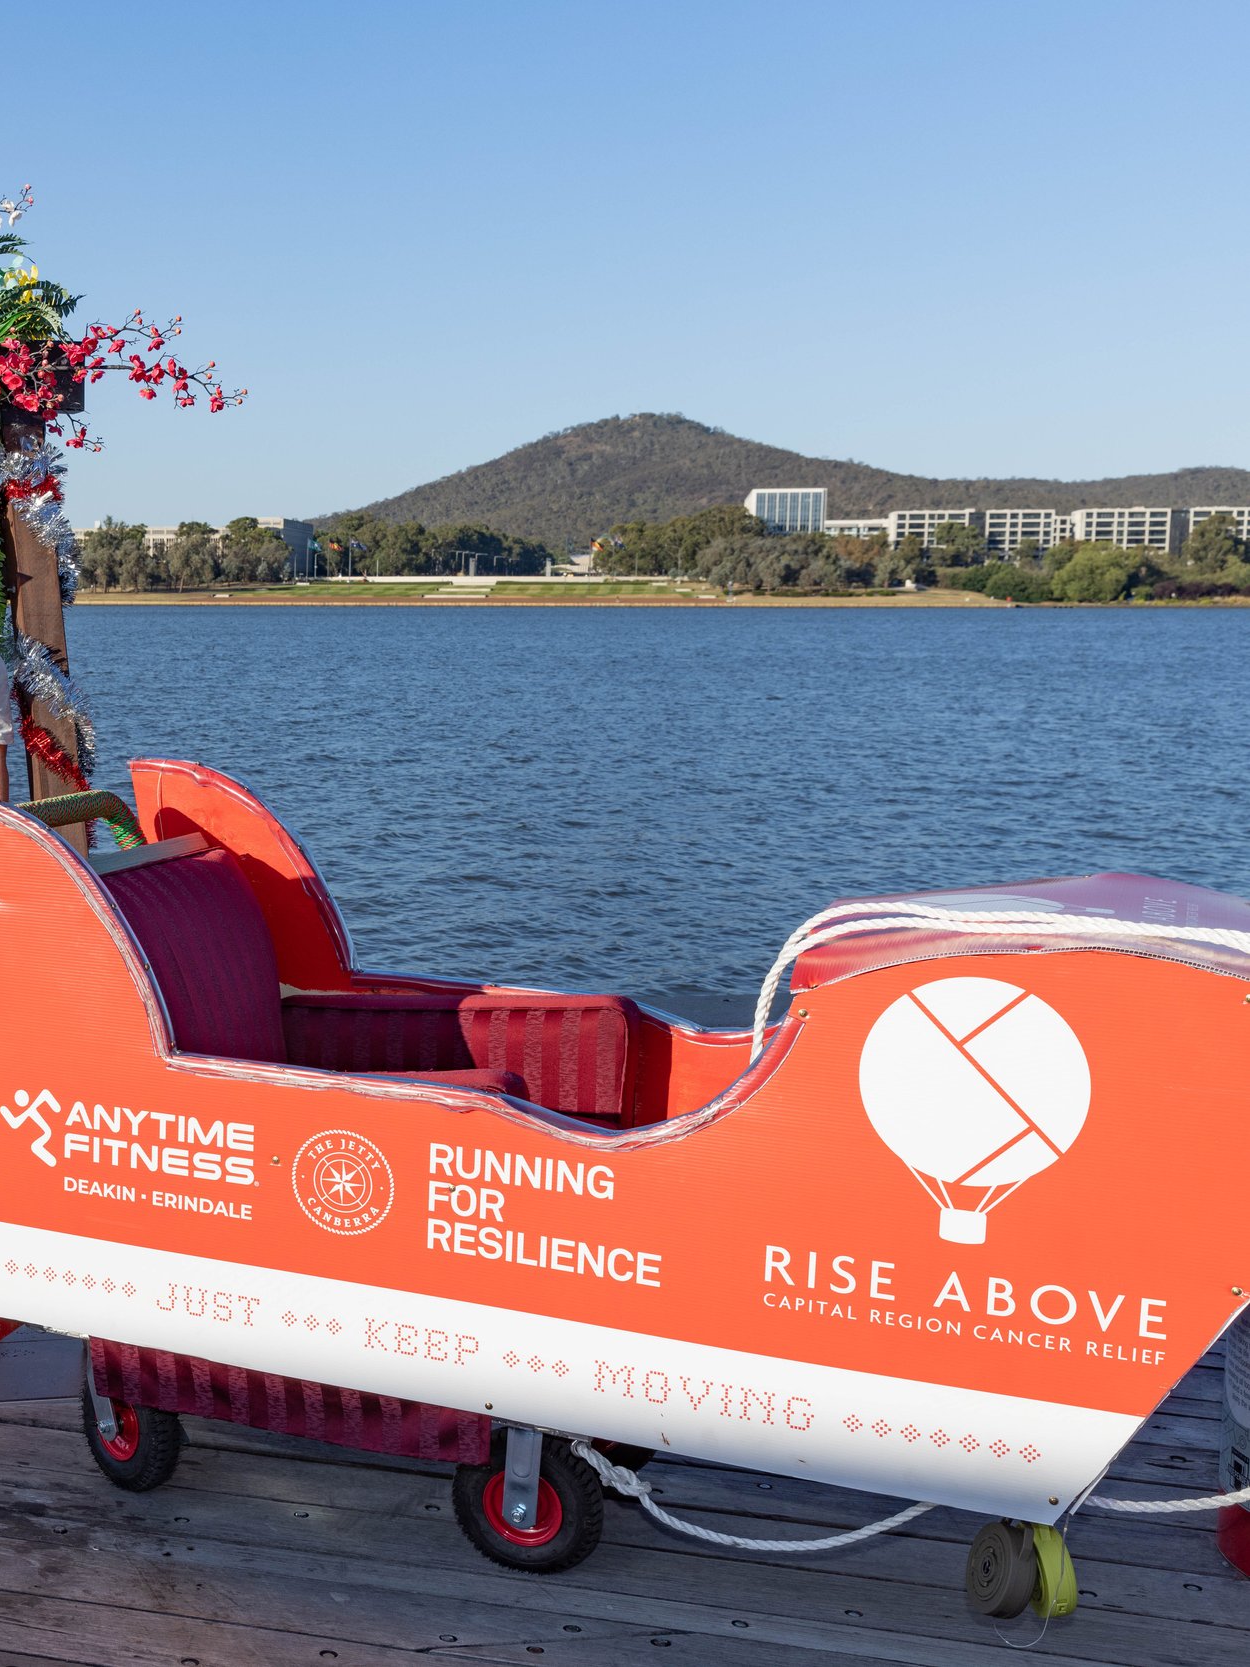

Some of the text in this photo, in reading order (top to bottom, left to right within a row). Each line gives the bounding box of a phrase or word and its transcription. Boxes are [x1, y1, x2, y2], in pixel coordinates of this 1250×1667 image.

[64, 1101, 255, 1152] ANYTIME
[63, 1132, 255, 1186] FITNESS
[307, 1138, 381, 1170] THE JETTY
[429, 1142, 615, 1200] RUNNING
[63, 1176, 253, 1221] DEAKIN ERINDALE
[307, 1197, 380, 1228] CANBERRA
[428, 1180, 505, 1223] FOR
[426, 1218, 663, 1288] RESILIENCE
[763, 1244, 1168, 1341] RISE ABOVE
[156, 1282, 815, 1431] JUST KEEP MOVING
[762, 1292, 1167, 1367] CAPITAL REGION CANCER RELIEF
